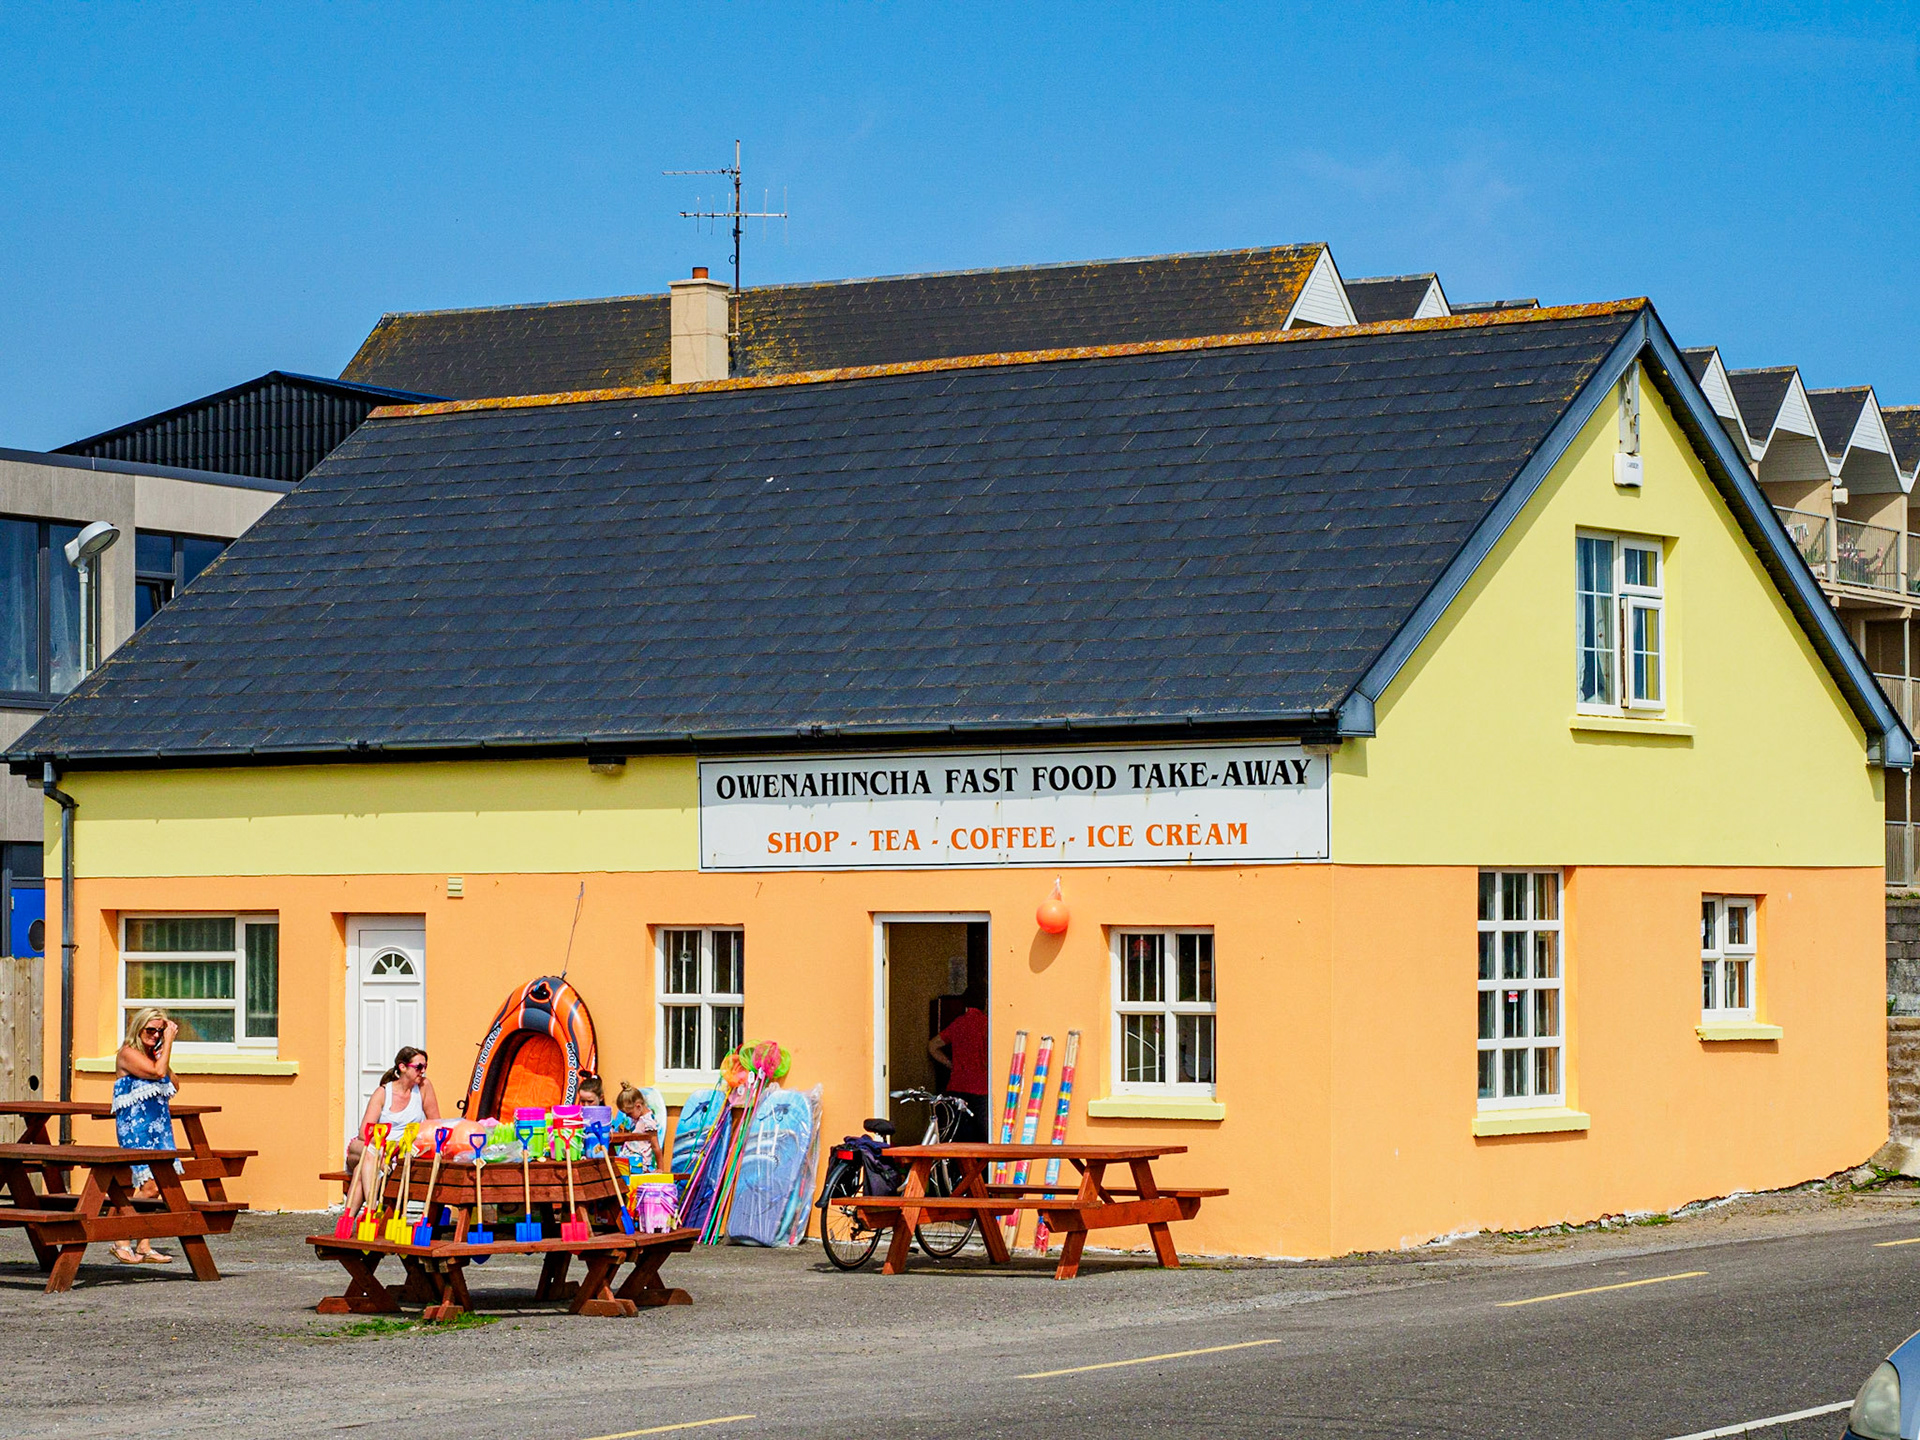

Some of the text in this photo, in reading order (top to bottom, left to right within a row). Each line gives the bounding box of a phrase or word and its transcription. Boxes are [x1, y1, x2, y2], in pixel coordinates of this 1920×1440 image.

[716, 758, 1312, 800] OWENAHINCHA FAST FOOD TAKE-AWAY
[767, 830, 840, 855] SHOP
[869, 829, 921, 852] TEA
[950, 826, 1056, 851] COFFEE
[1087, 824, 1134, 848] ICE
[1145, 822, 1249, 848] CREAM
[472, 1064, 485, 1092] 2000
[564, 1070, 577, 1105] ONDOR
